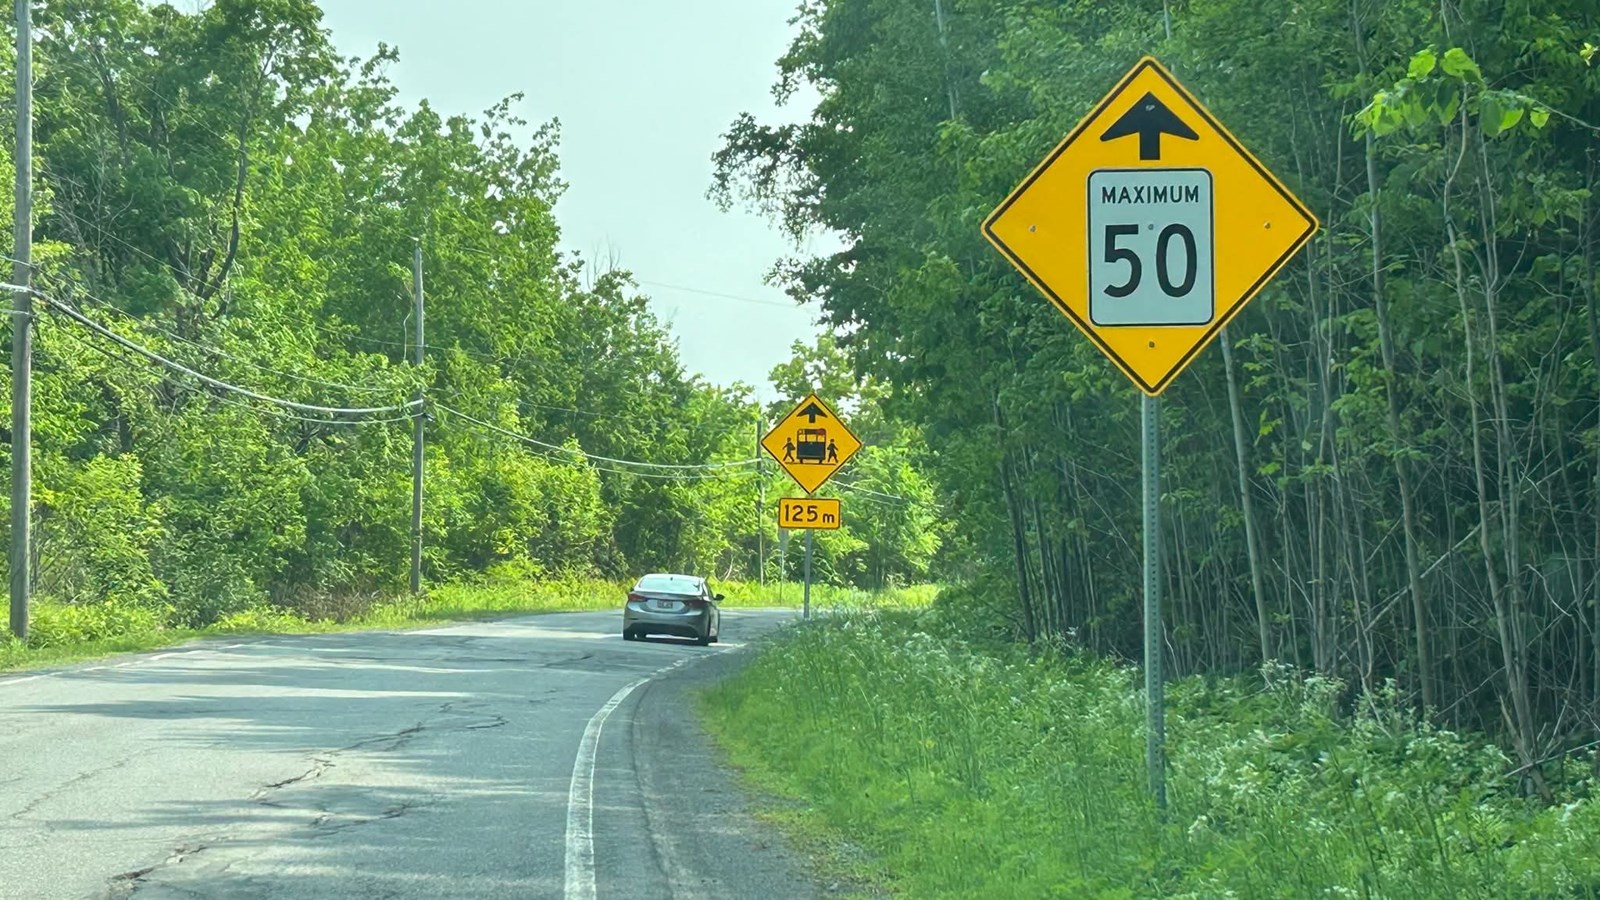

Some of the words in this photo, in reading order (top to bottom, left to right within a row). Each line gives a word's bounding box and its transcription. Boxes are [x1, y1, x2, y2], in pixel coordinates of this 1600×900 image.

[1102, 185, 1199, 204] MAXIMUM
[1103, 223, 1198, 298] 50
[785, 504, 818, 522] 125
[822, 513, 835, 523] m
